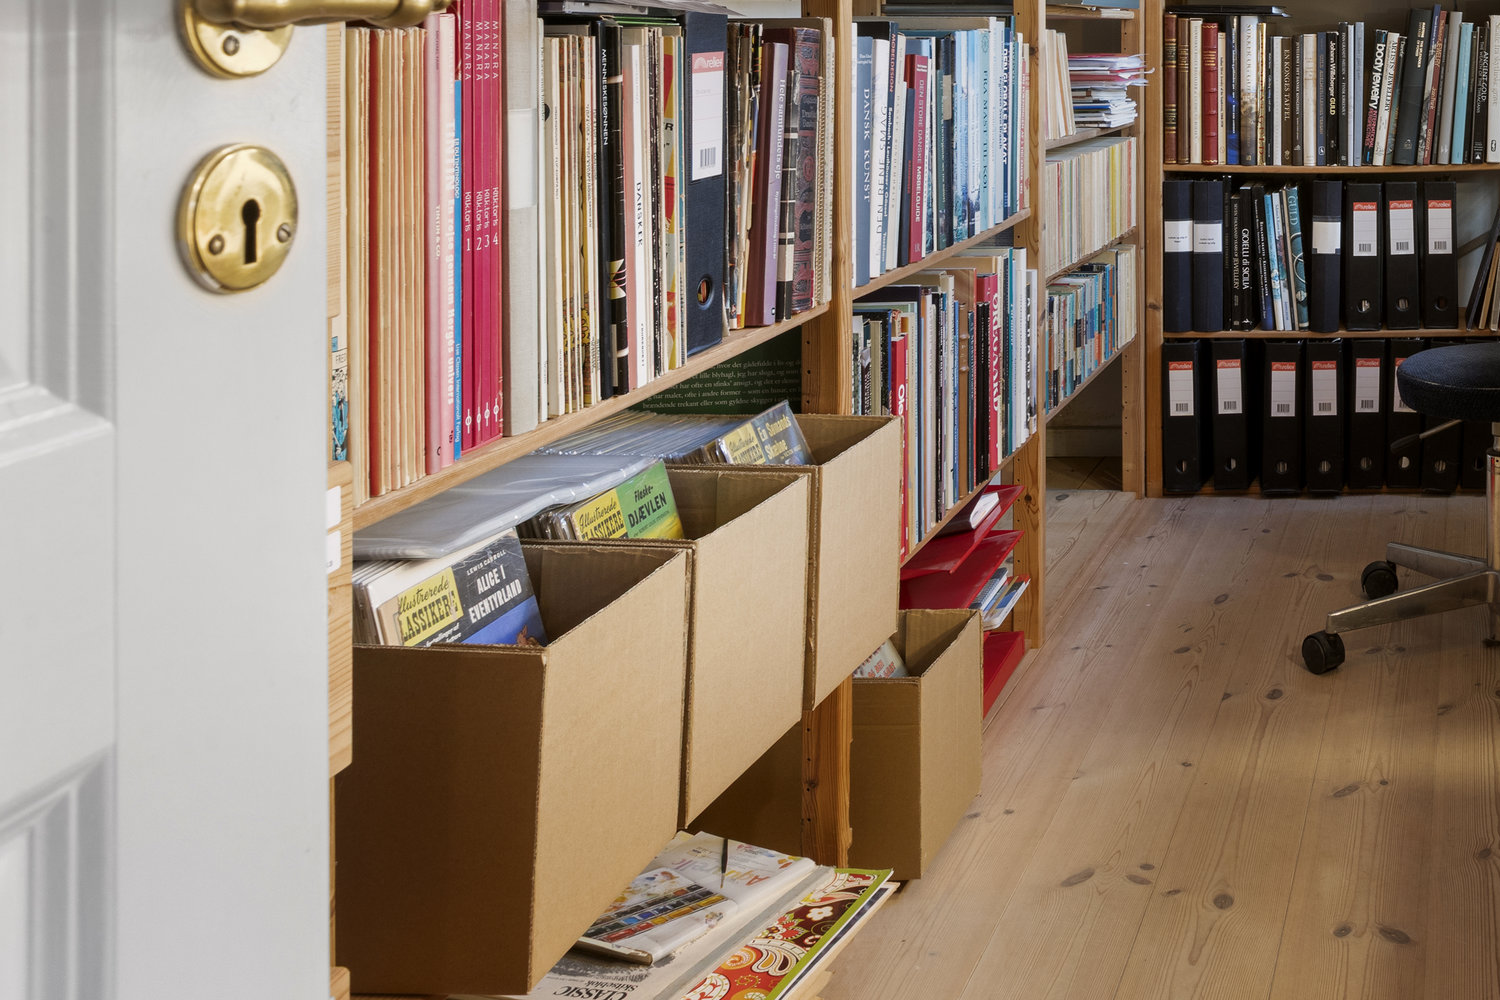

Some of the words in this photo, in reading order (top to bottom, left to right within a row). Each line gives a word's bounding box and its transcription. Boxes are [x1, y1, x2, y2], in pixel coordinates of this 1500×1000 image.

[889, 33, 897, 93] MØBELDESIGN
[1283, 48, 1290, 60] EN
[1373, 43, 1386, 72] body
[1328, 63, 1336, 97] Willsberger
[1368, 71, 1383, 110] jewelry
[1384, 72, 1394, 113] JEWELLERY
[1328, 97, 1336, 115] GULD
[775, 103, 785, 163] samfundets
[773, 163, 781, 180] eje
[1287, 195, 1297, 226] GULD
[1242, 266, 1250, 290] SICILIA
[627, 492, 668, 529] DJÆVLEN
[467, 564, 482, 577] LEWIS
[483, 550, 507, 568] CARROLL
[476, 570, 501, 595] ALICE
[499, 564, 507, 580] I
[398, 574, 451, 614] llustrerede
[468, 578, 523, 624] EVENTYRLAND
